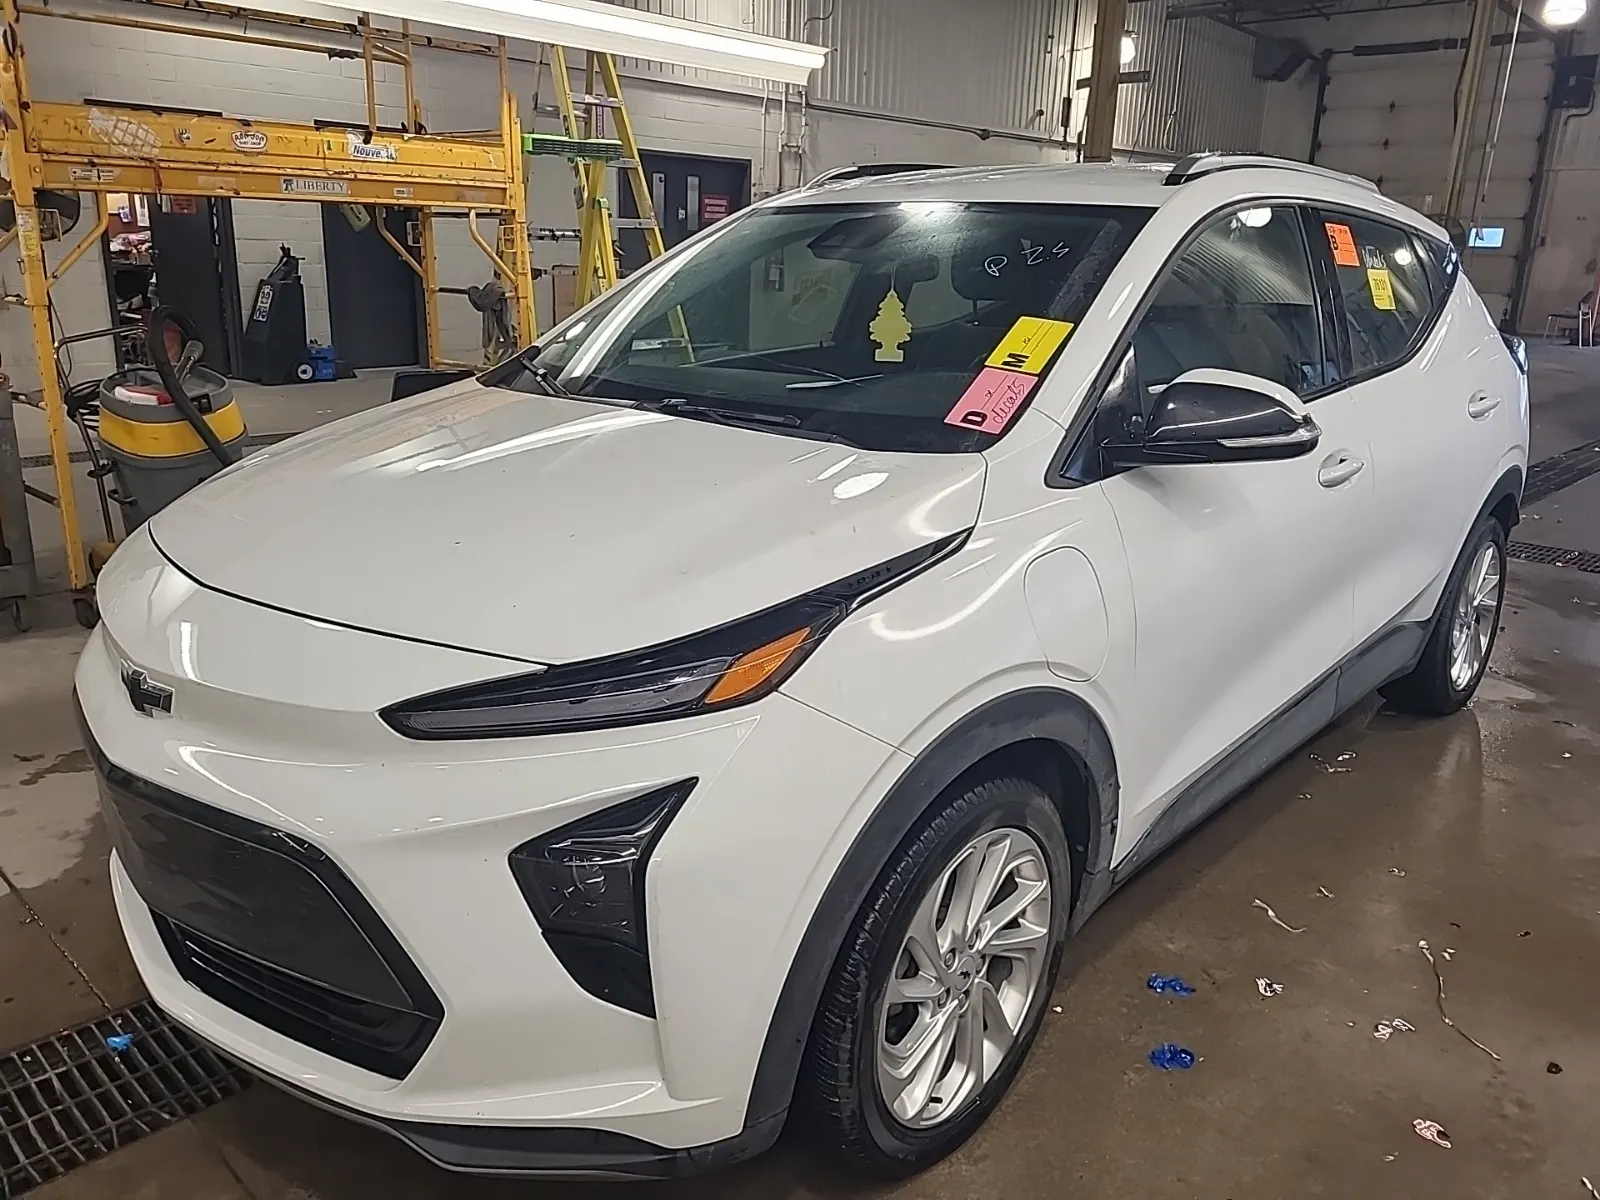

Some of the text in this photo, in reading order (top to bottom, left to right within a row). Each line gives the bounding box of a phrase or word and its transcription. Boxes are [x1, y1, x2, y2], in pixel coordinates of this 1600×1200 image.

[296, 180, 346, 192] LIBERTY
[1000, 352, 1031, 368] M
[959, 410, 988, 427] D
